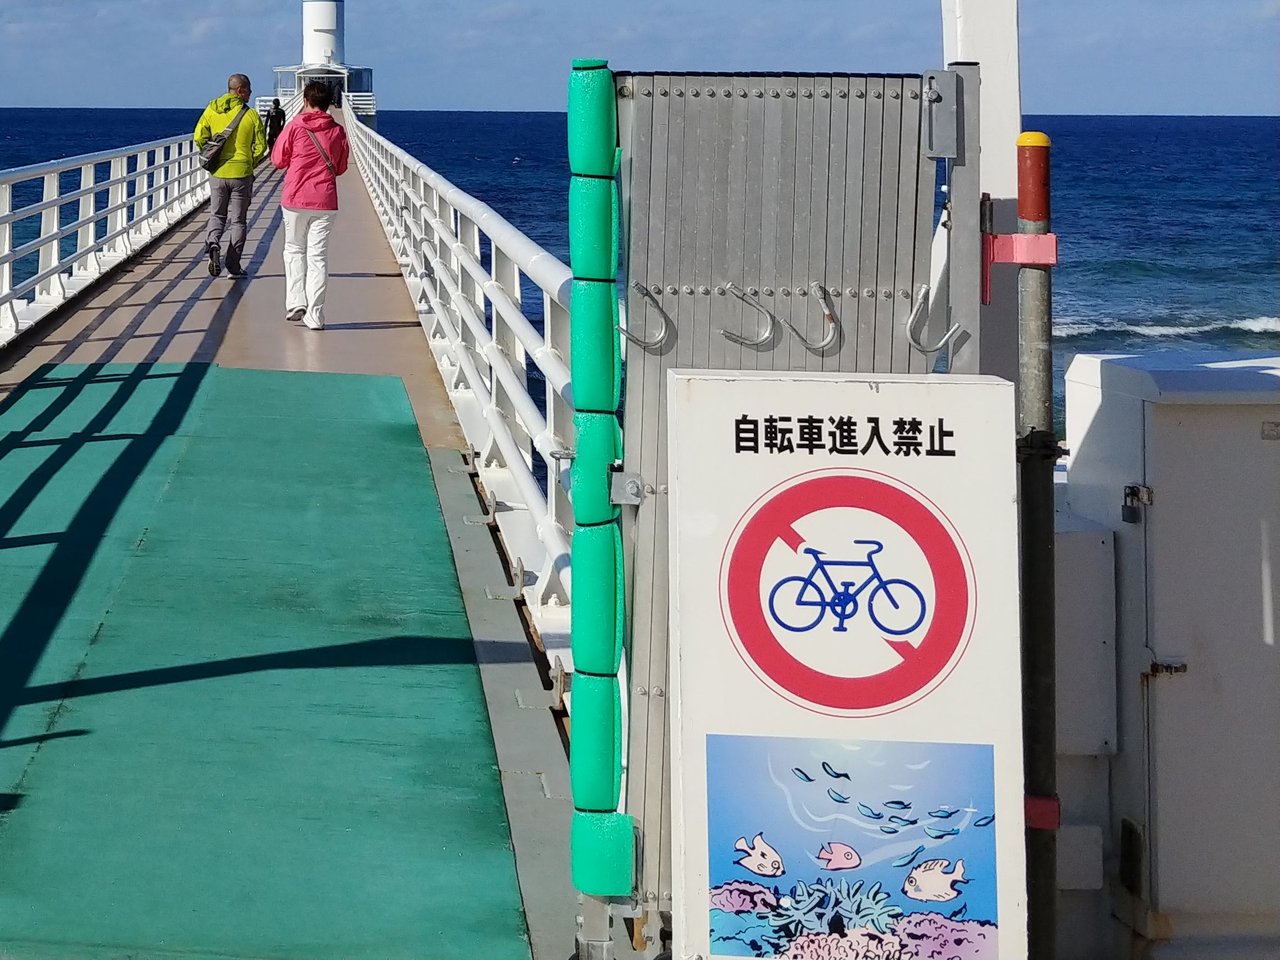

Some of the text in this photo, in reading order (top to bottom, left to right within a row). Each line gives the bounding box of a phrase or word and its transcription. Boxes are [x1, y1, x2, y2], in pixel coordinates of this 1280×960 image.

[734, 413, 957, 457] 自転車進入禁止
